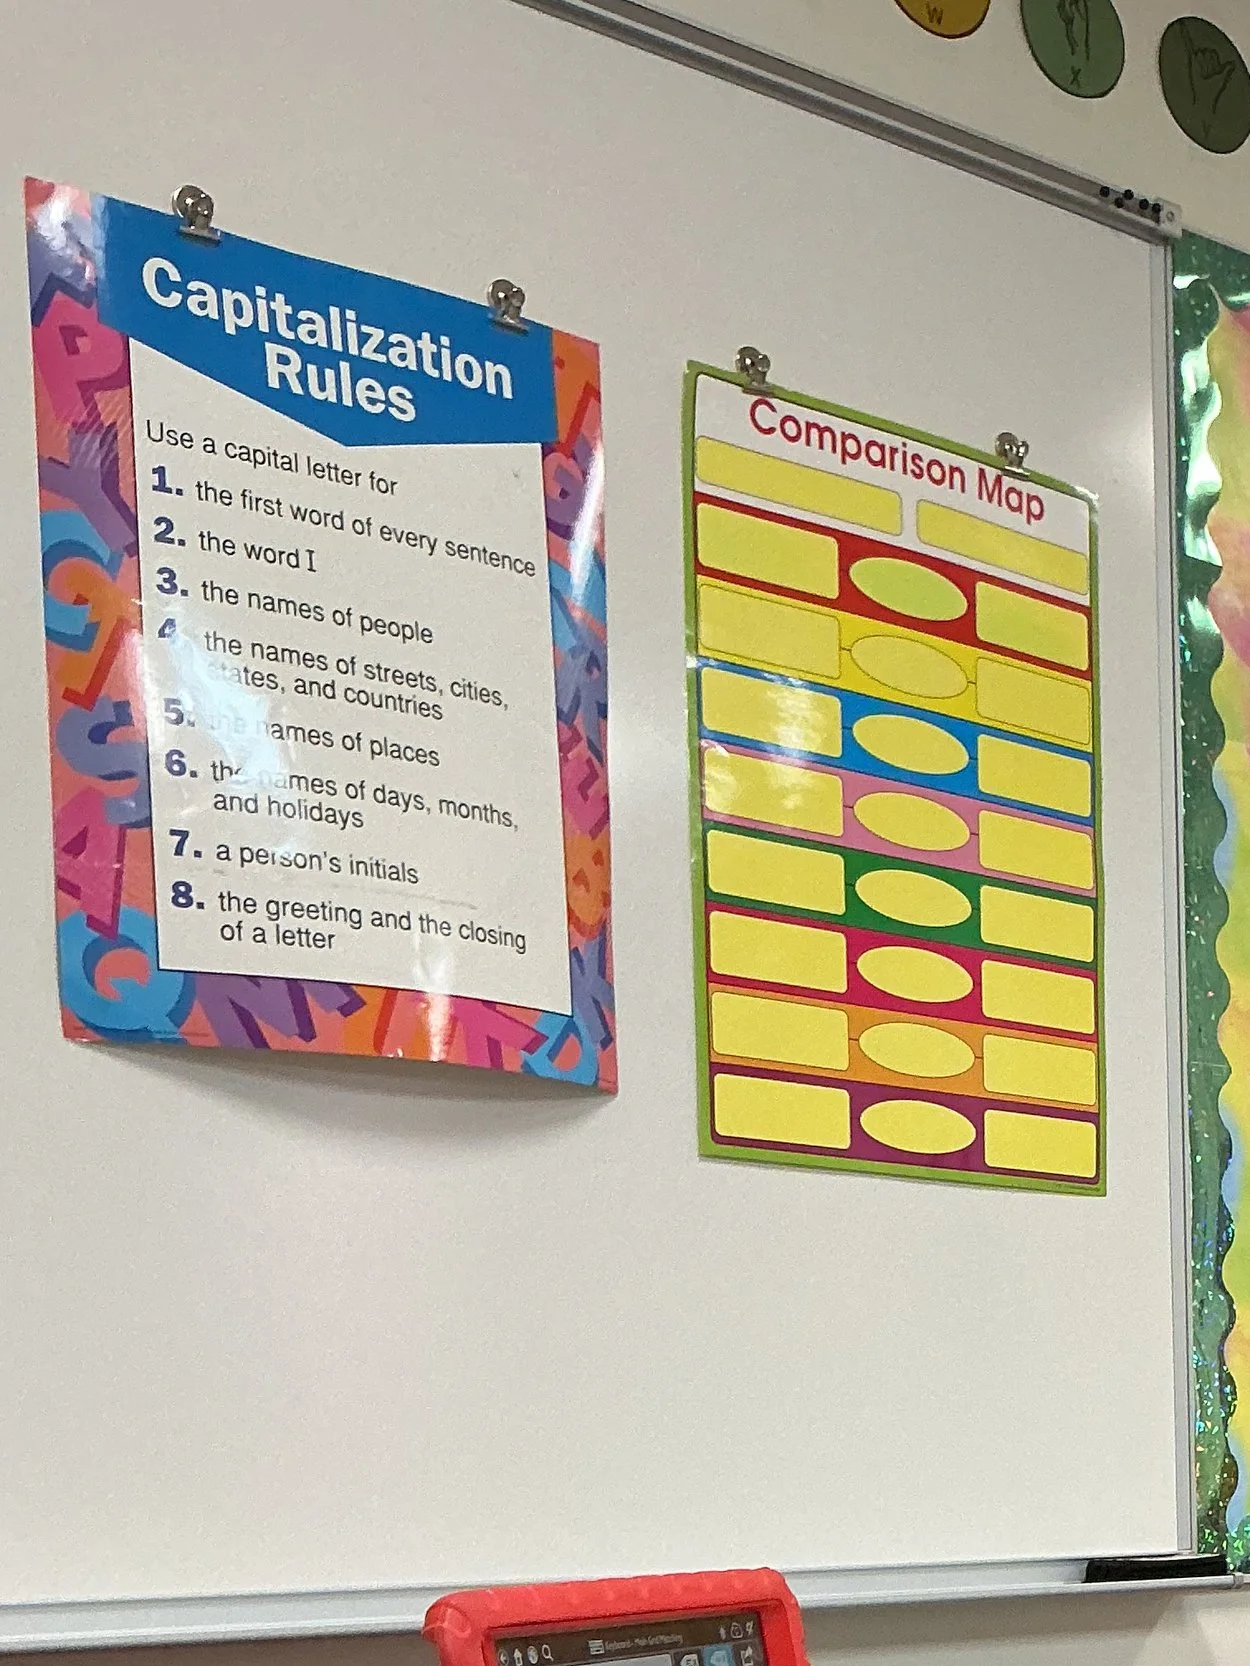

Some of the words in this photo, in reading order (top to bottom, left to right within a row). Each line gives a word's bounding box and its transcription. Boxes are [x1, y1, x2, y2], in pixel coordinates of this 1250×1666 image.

[925, 2, 945, 26] W
[1069, 65, 1083, 89] X
[142, 256, 514, 400] Capitalization
[264, 342, 418, 423] Rules
[146, 419, 194, 450] Use
[202, 436, 218, 456] a
[224, 442, 299, 474] capital
[306, 455, 363, 487] letter
[368, 470, 399, 496] for
[749, 397, 967, 494] Comparison
[977, 468, 1046, 524] Map
[151, 465, 184, 497] 1.
[194, 480, 233, 507] the
[240, 488, 284, 518] first
[289, 503, 345, 531] word
[351, 516, 373, 538] of
[379, 524, 438, 557] every
[444, 540, 536, 578] sentence
[153, 516, 187, 548] 2.
[197, 530, 236, 557] the
[243, 542, 301, 570] word
[155, 566, 189, 597] 3.
[200, 579, 239, 606] the
[247, 592, 326, 623] names
[331, 606, 353, 628] of
[359, 614, 434, 645] people
[203, 630, 243, 656] the
[250, 642, 329, 672] names
[335, 655, 357, 677] of
[363, 662, 444, 699] streets,
[449, 677, 509, 712] cities,
[293, 677, 337, 700] and
[343, 686, 444, 721] countries
[163, 697, 196, 728] 5.
[341, 731, 363, 753] of
[369, 736, 441, 767] places
[164, 748, 199, 779] 6.
[210, 759, 248, 786] th
[257, 769, 338, 799] names
[344, 779, 366, 801] of
[372, 783, 431, 816] days,
[438, 798, 519, 832] months,
[213, 792, 259, 814] and
[267, 796, 364, 831] holidays
[168, 828, 203, 859] 7.
[215, 843, 233, 862] a
[239, 846, 342, 874] person's
[348, 853, 419, 885] initials
[170, 880, 205, 911] 8.
[217, 890, 258, 915] the
[265, 898, 363, 931] greeting
[370, 910, 412, 931] and
[417, 913, 452, 937] the
[458, 920, 527, 955] closing
[219, 919, 244, 942] of
[251, 926, 268, 945] a
[275, 922, 336, 950] letter
